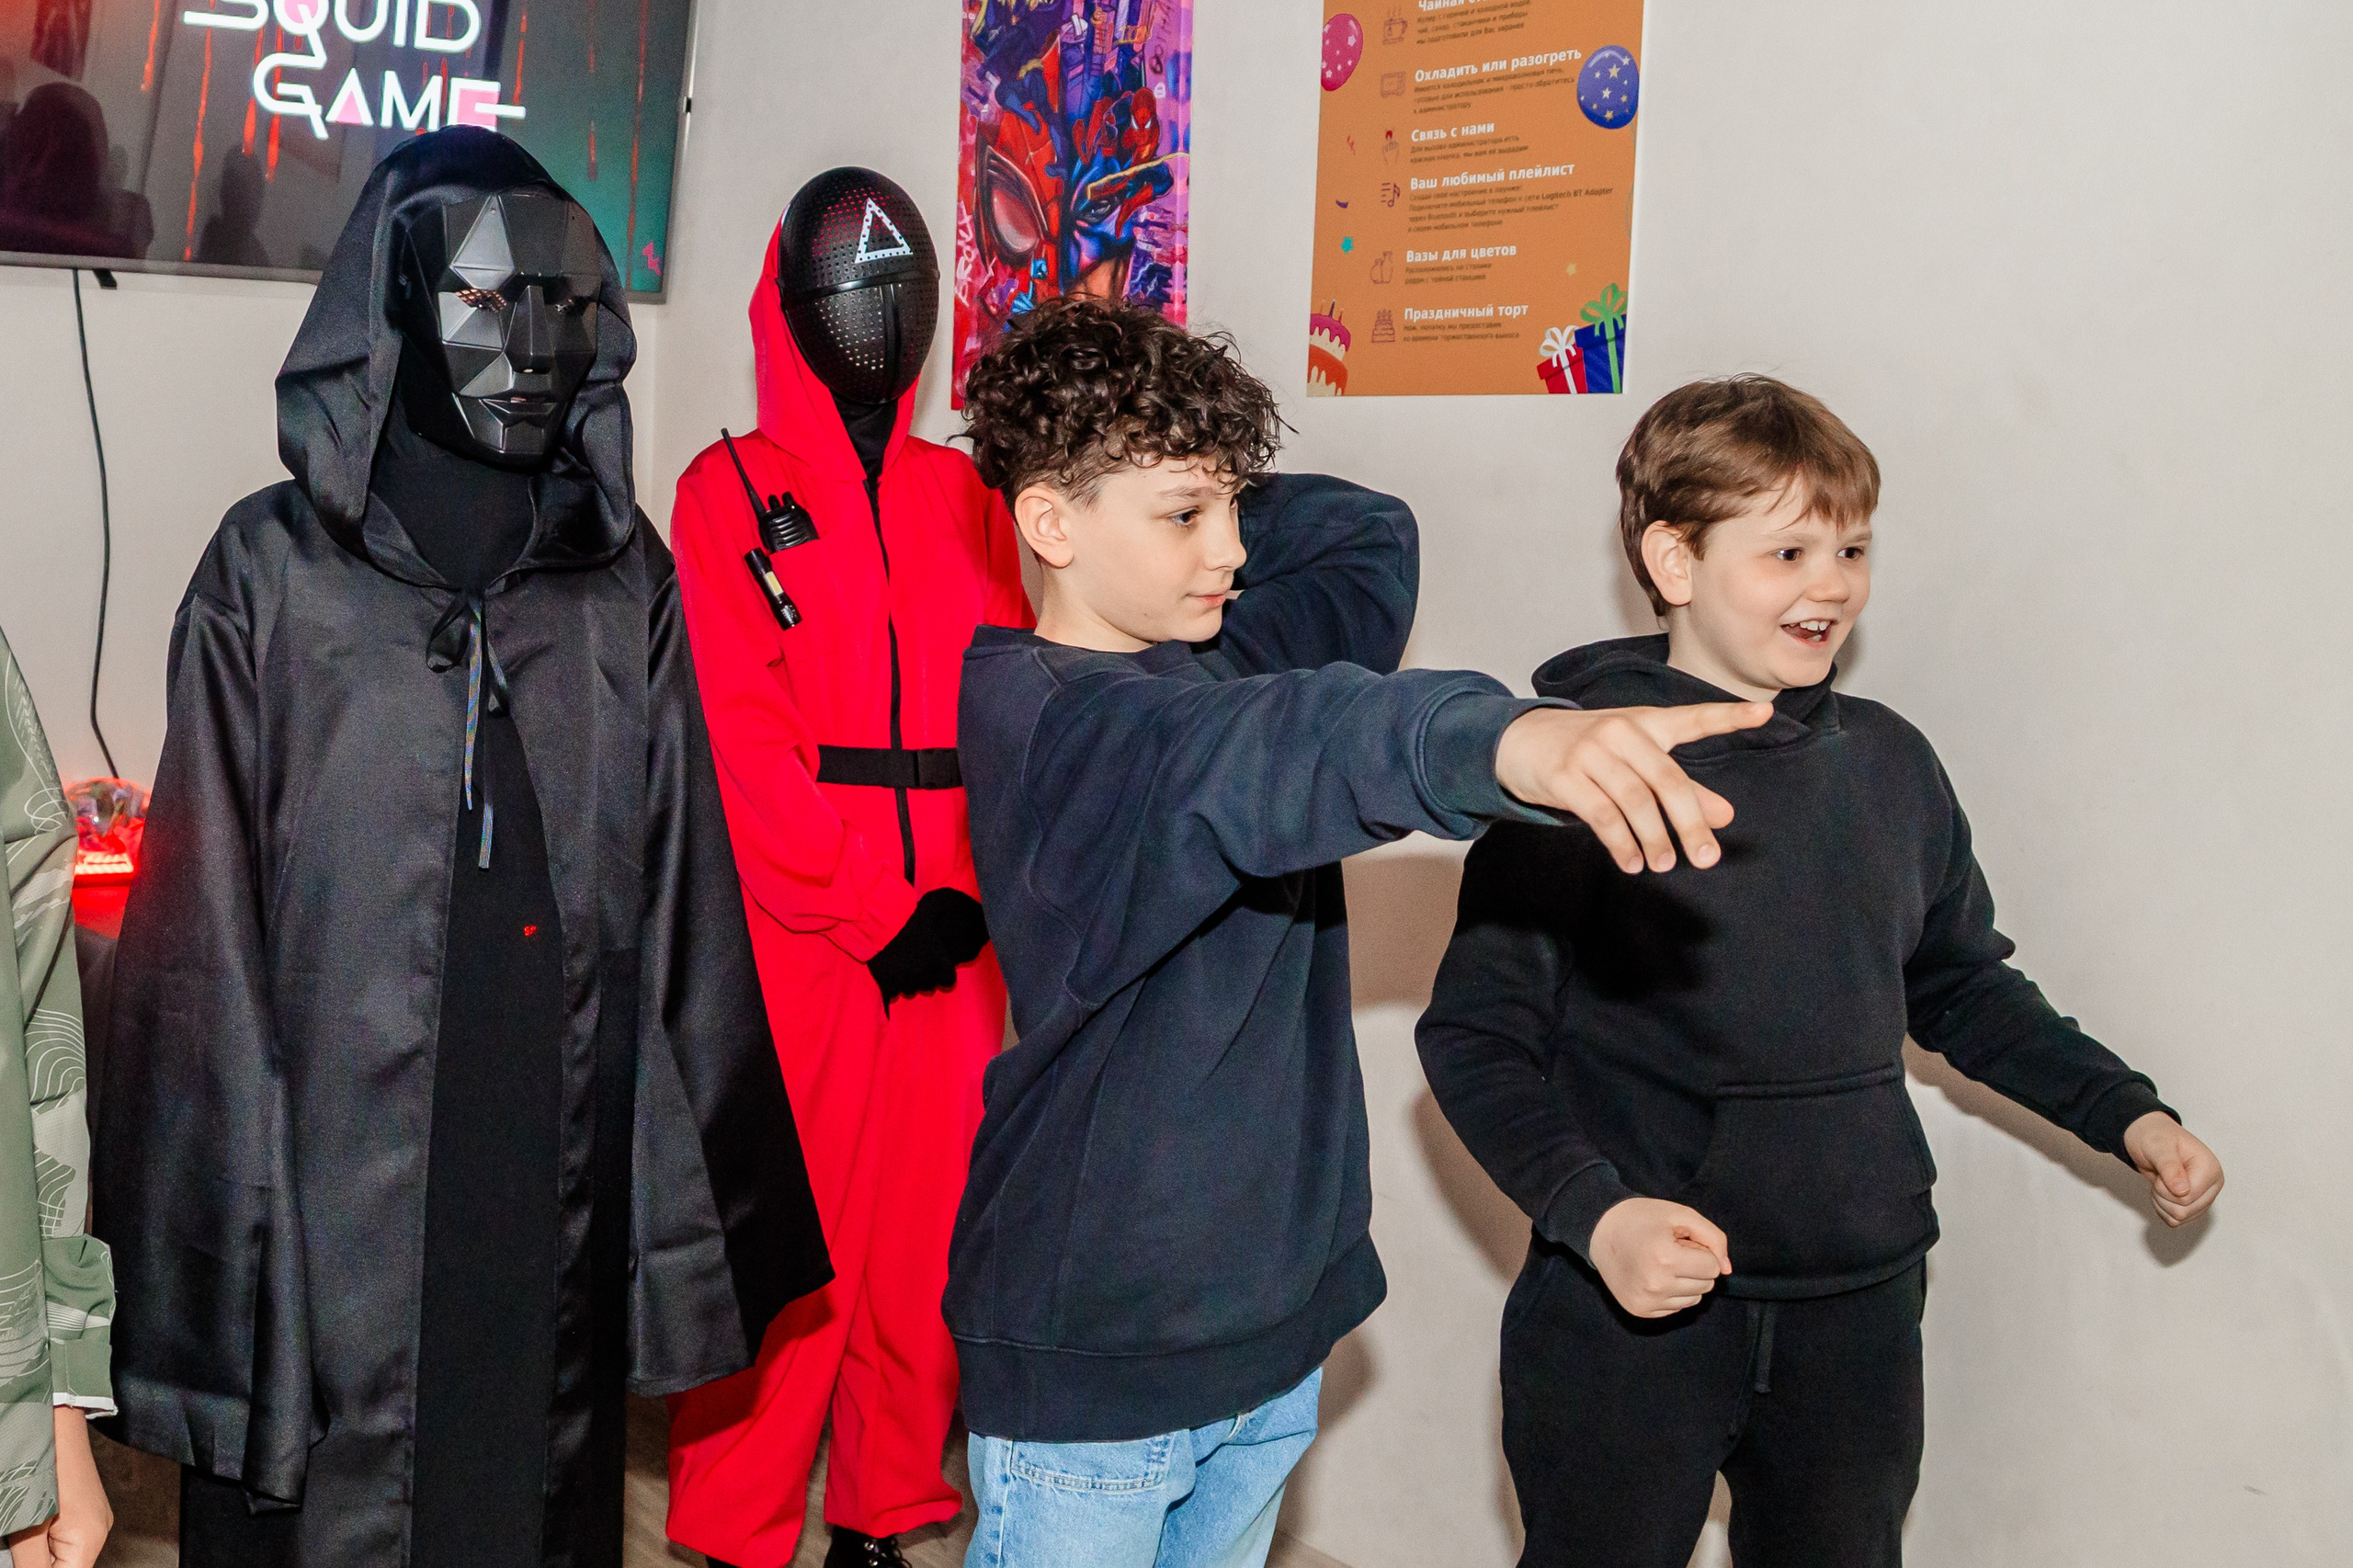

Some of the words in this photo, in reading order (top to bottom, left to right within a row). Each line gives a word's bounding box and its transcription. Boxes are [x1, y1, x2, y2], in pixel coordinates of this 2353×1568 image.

[183, 0, 482, 53] SQUID
[1415, 64, 1478, 83] Охладить
[1482, 60, 1507, 73] или
[1511, 49, 1582, 71] разогреть
[253, 52, 526, 140] GAME
[1410, 127, 1448, 142] Связь
[1449, 126, 1458, 138] с
[1461, 121, 1495, 137] нами
[1409, 177, 1438, 190] Ваш
[1441, 167, 1506, 187] любимый
[1508, 164, 1575, 181] плейлист
[1405, 249, 1438, 263] Вазы
[1441, 247, 1467, 261] для
[1470, 245, 1518, 259] цветов
[1404, 304, 1494, 324] Праздничный
[1498, 304, 1529, 319] торт
